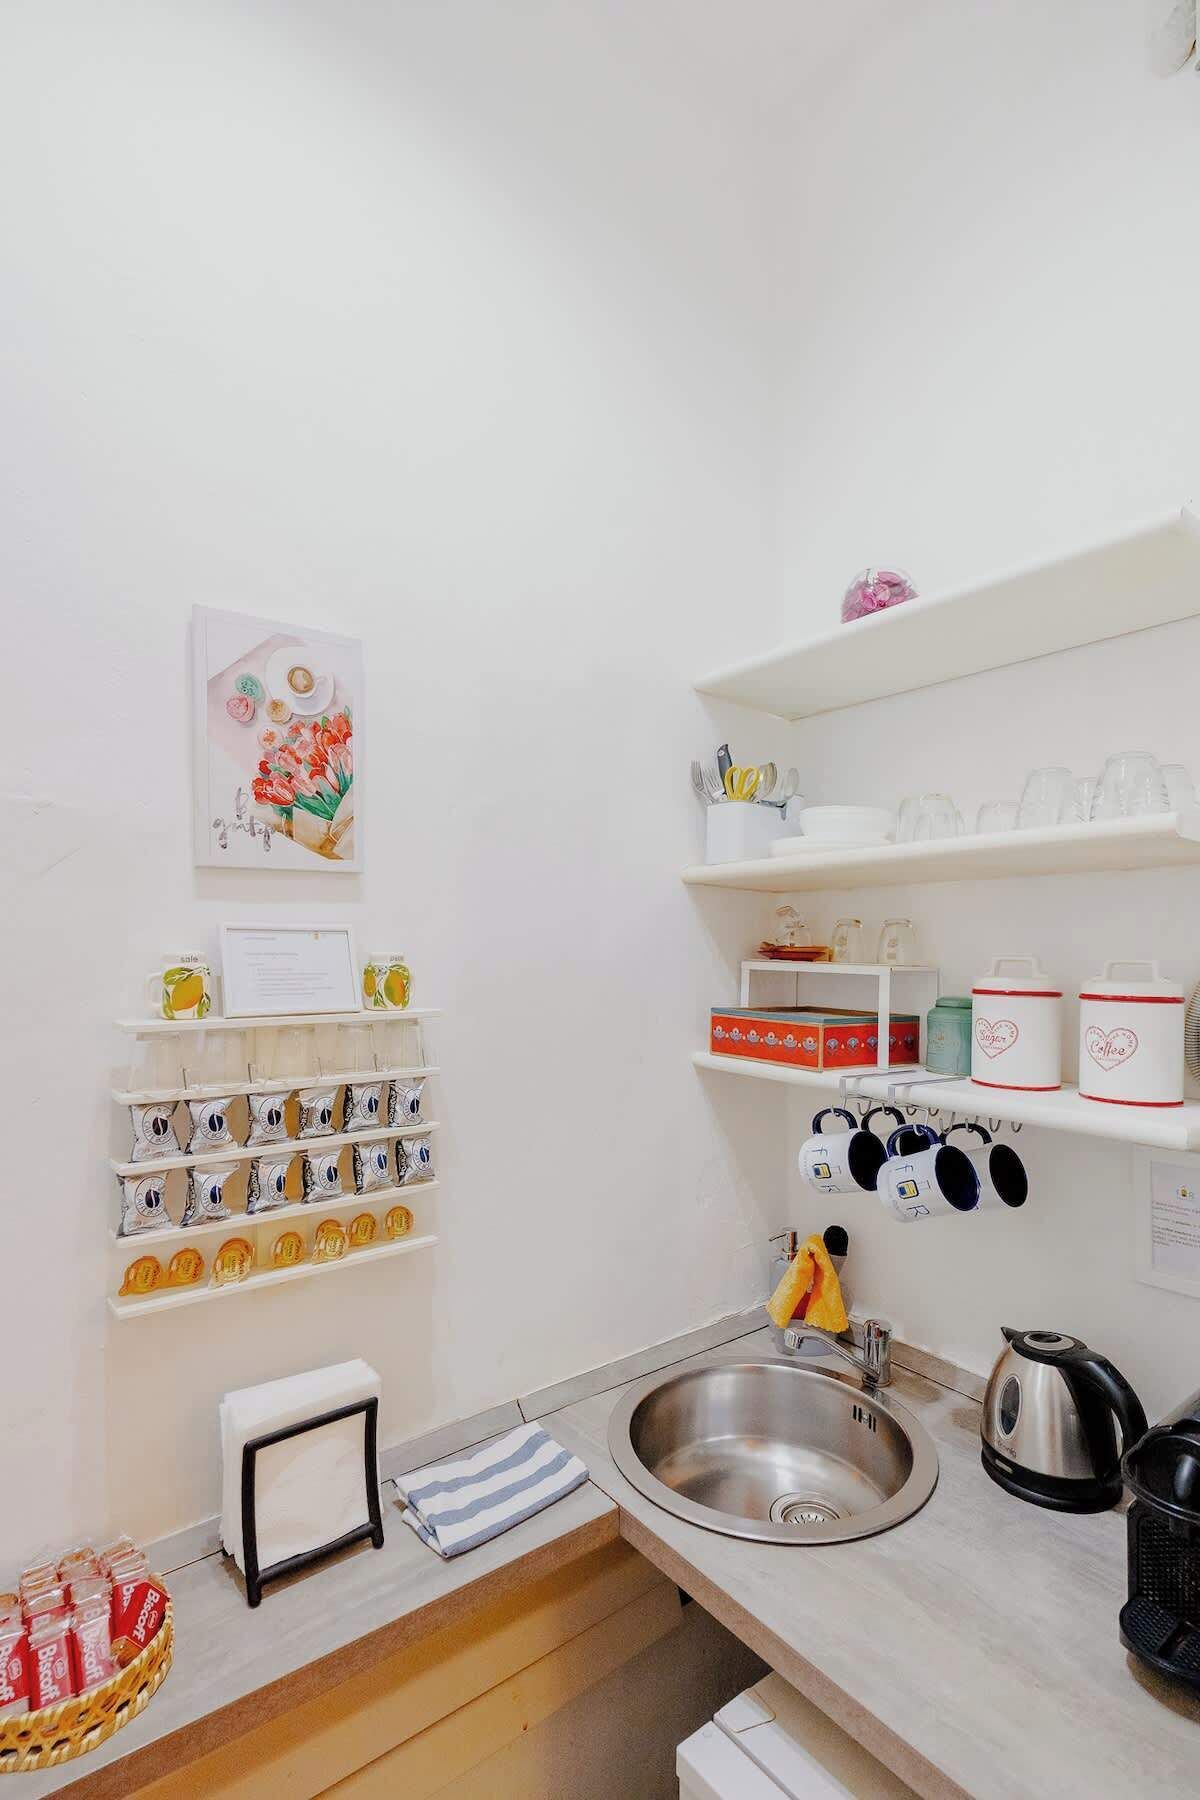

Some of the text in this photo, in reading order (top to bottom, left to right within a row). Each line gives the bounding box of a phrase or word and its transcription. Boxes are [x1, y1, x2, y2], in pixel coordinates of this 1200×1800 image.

[180, 955, 199, 963] sale
[980, 1029, 1007, 1046] Sugar
[1090, 1038, 1127, 1057] Coffee
[131, 1589, 161, 1643] Biscoff
[83, 1631, 105, 1681] Biscoff
[37, 1643, 62, 1705] Biscoff
